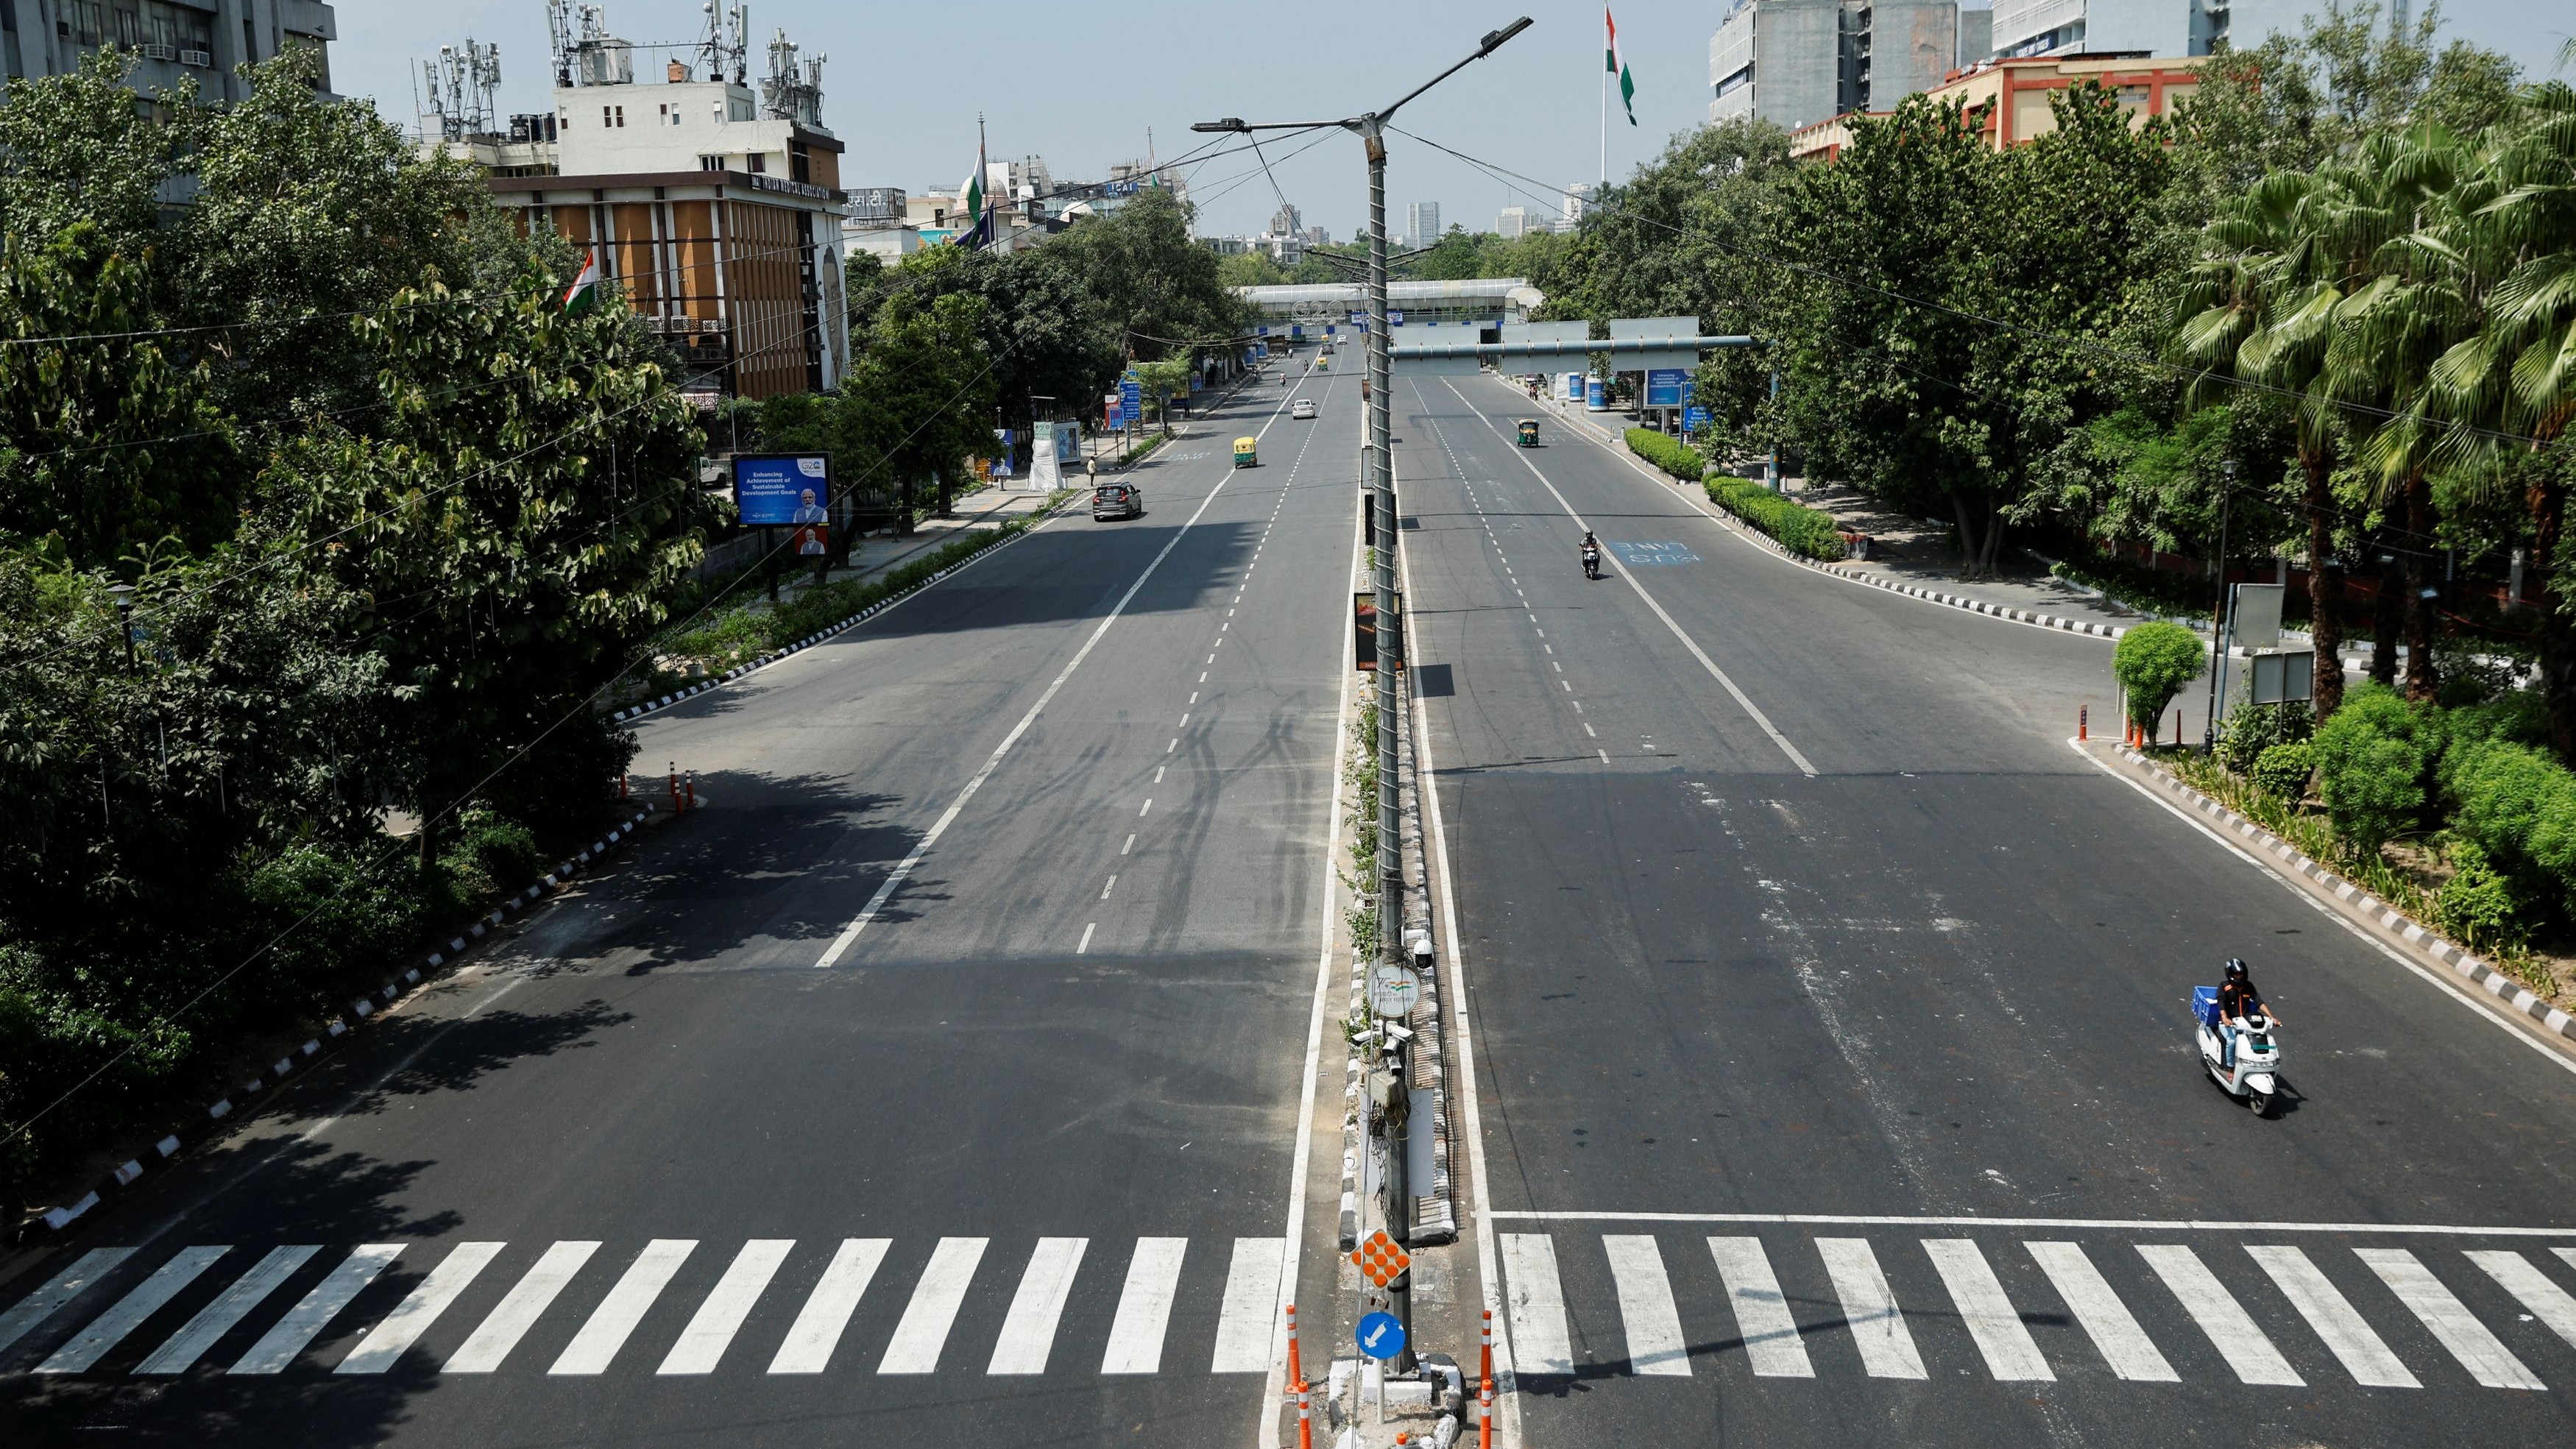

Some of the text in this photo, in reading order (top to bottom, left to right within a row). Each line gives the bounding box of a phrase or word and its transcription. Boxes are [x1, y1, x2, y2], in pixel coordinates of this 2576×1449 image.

[762, 176, 829, 200] INDIAN MEDICAL ASSOCIATION
[1111, 183, 1133, 191] ICAI
[1291, 300, 1346, 319] G20
[1616, 542, 1688, 550] LANE
[1629, 554, 1699, 562] BUS
